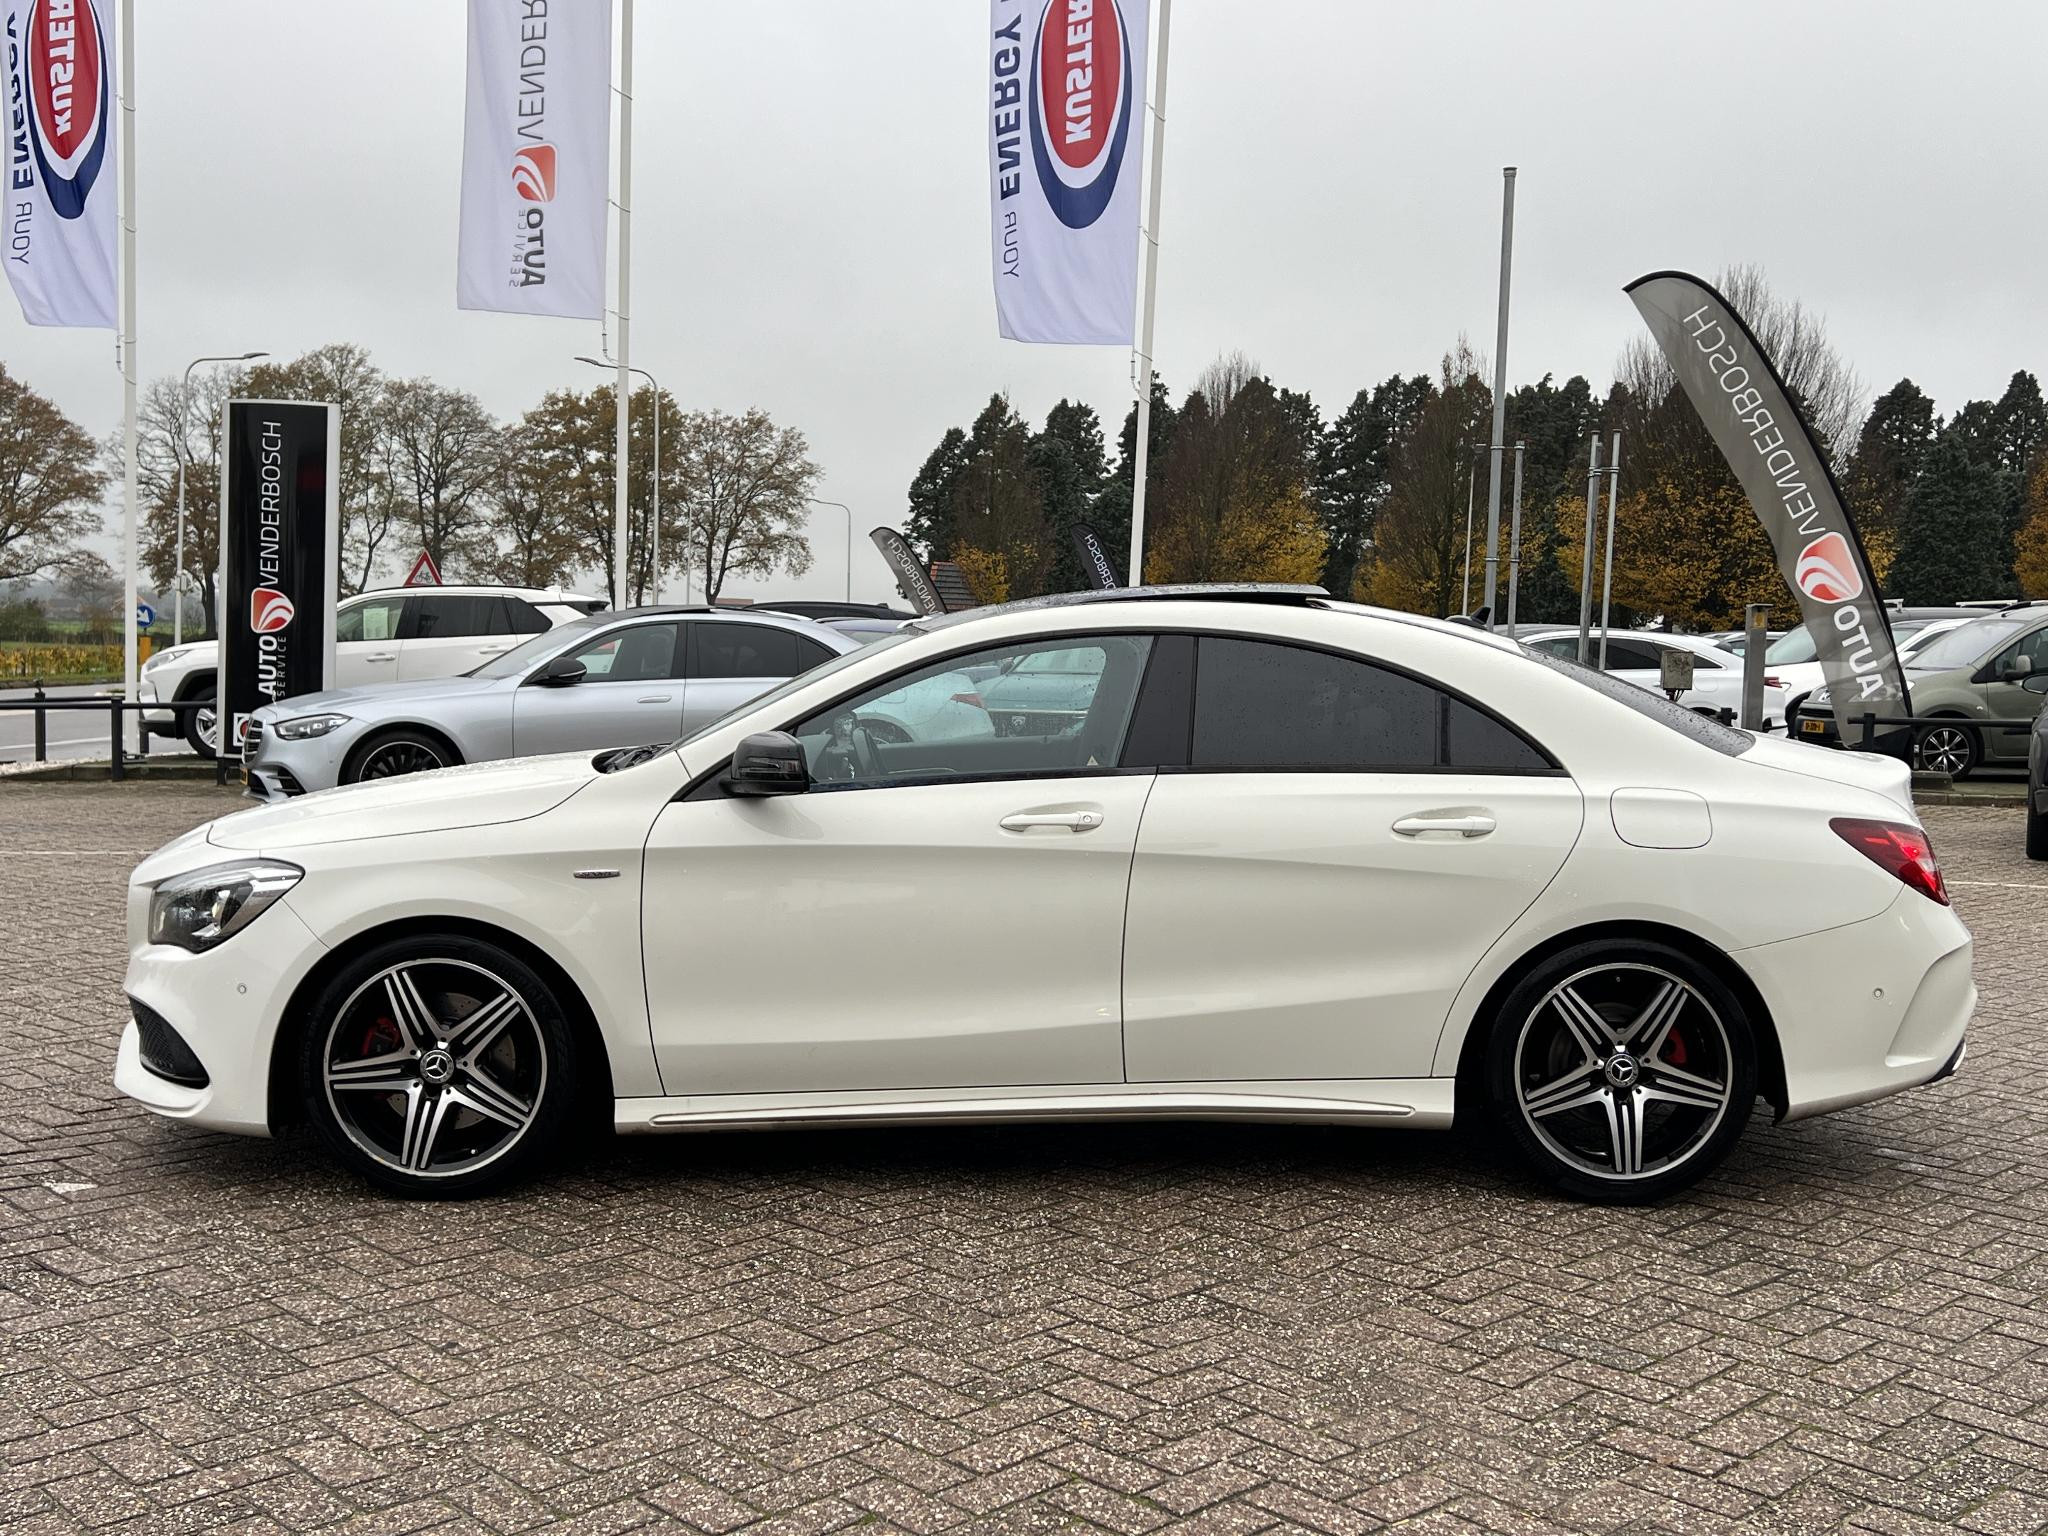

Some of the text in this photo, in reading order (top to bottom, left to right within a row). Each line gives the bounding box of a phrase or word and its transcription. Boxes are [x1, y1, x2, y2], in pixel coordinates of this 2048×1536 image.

[258, 421, 282, 696] AUTO VENDERBOSCH
[276, 635, 287, 697] SERVICE
